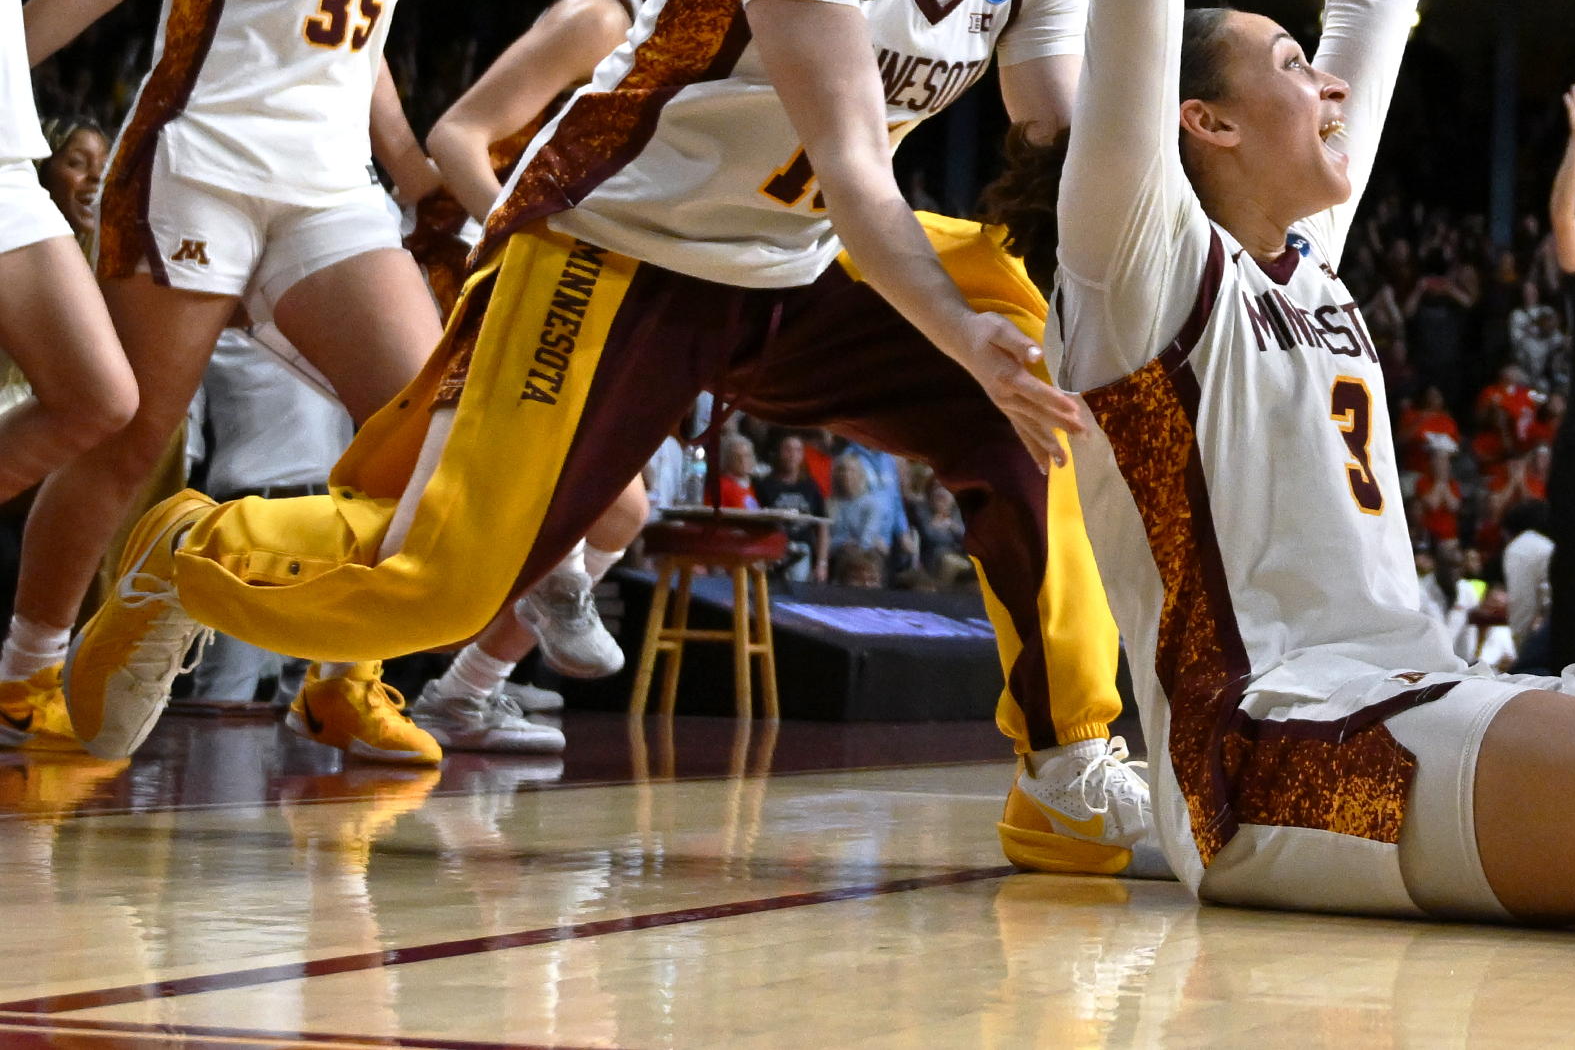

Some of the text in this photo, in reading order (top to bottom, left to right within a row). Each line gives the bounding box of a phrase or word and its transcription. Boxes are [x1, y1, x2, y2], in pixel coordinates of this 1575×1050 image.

[170, 239, 211, 266] M
[520, 238, 608, 406] MINNESOTA
[1330, 374, 1386, 517] 3
